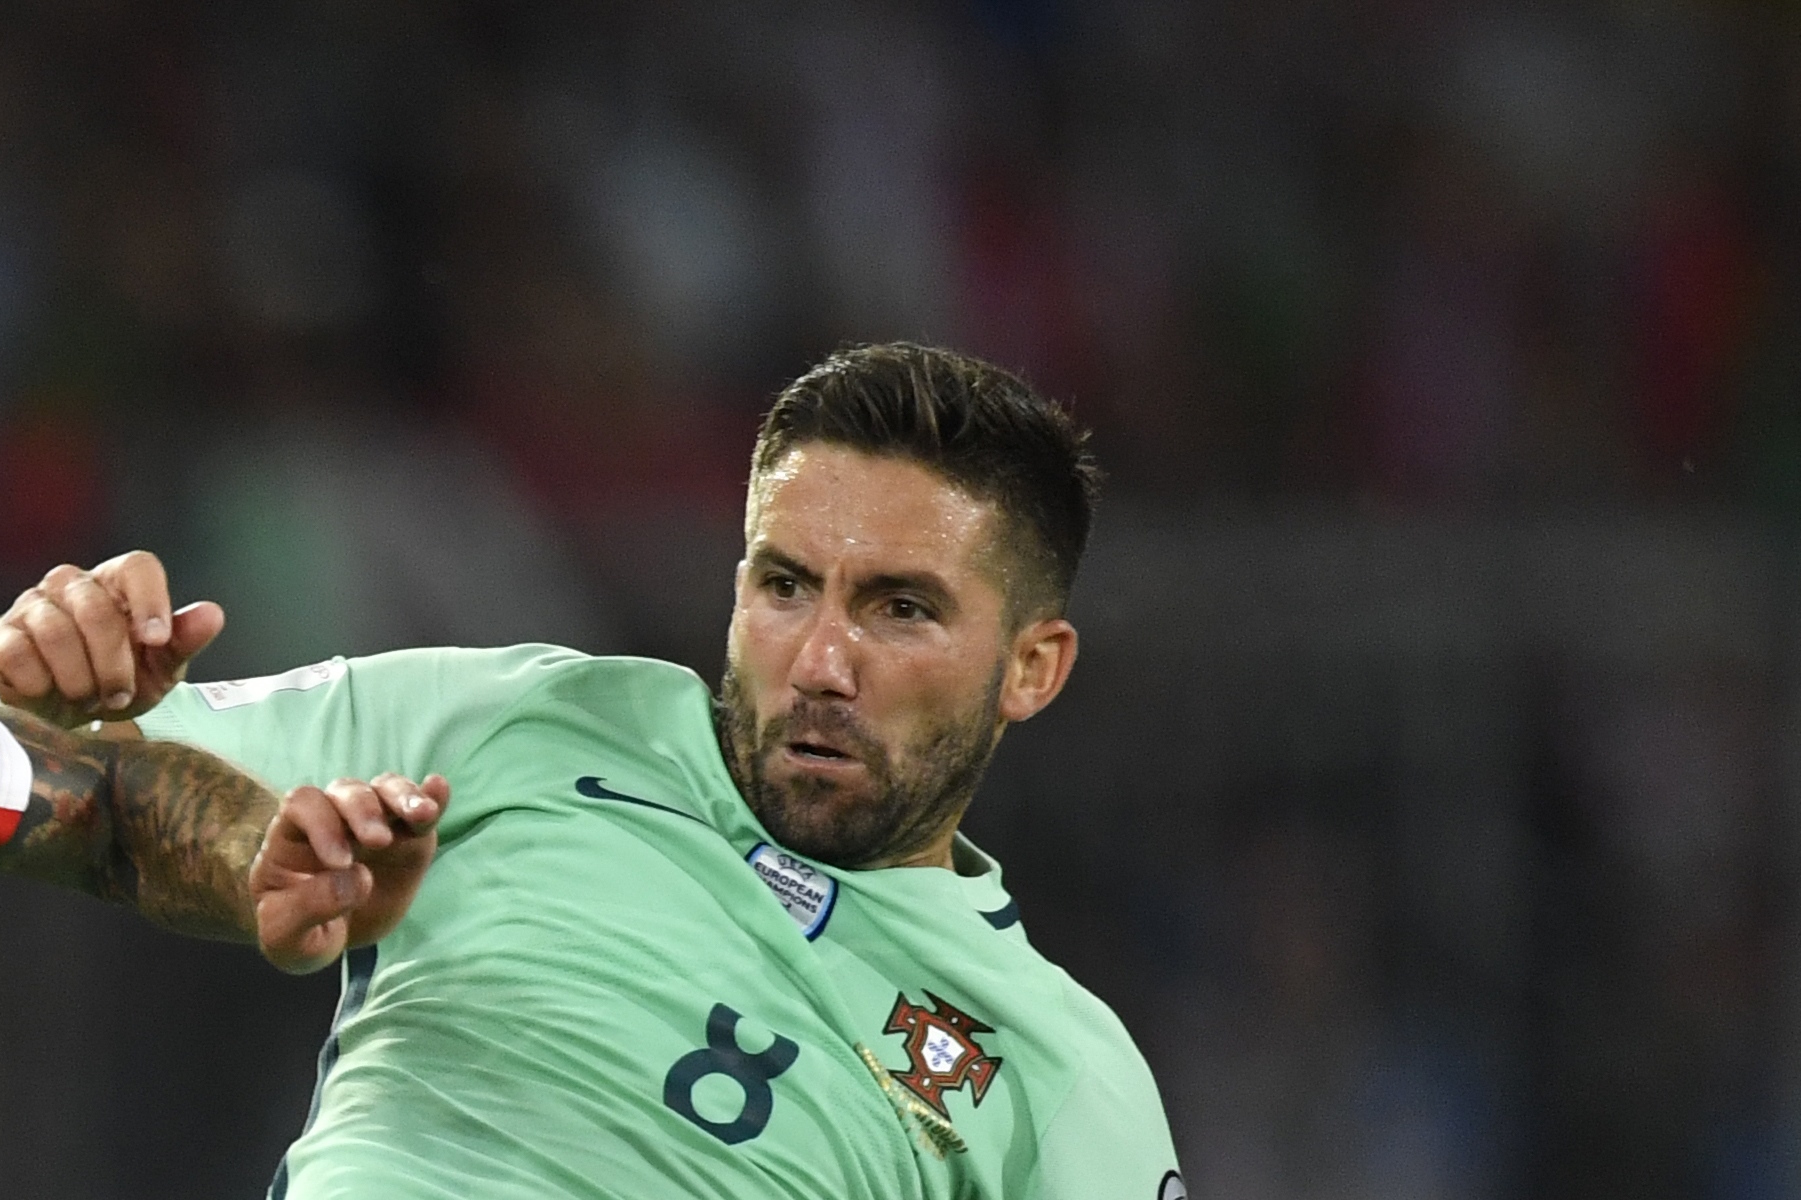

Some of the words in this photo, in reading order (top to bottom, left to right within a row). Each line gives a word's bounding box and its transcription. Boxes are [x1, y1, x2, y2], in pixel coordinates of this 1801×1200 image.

[755, 862, 825, 904] EUROPEAN
[764, 879, 817, 914] AMPIONS
[663, 1002, 801, 1146] 8
